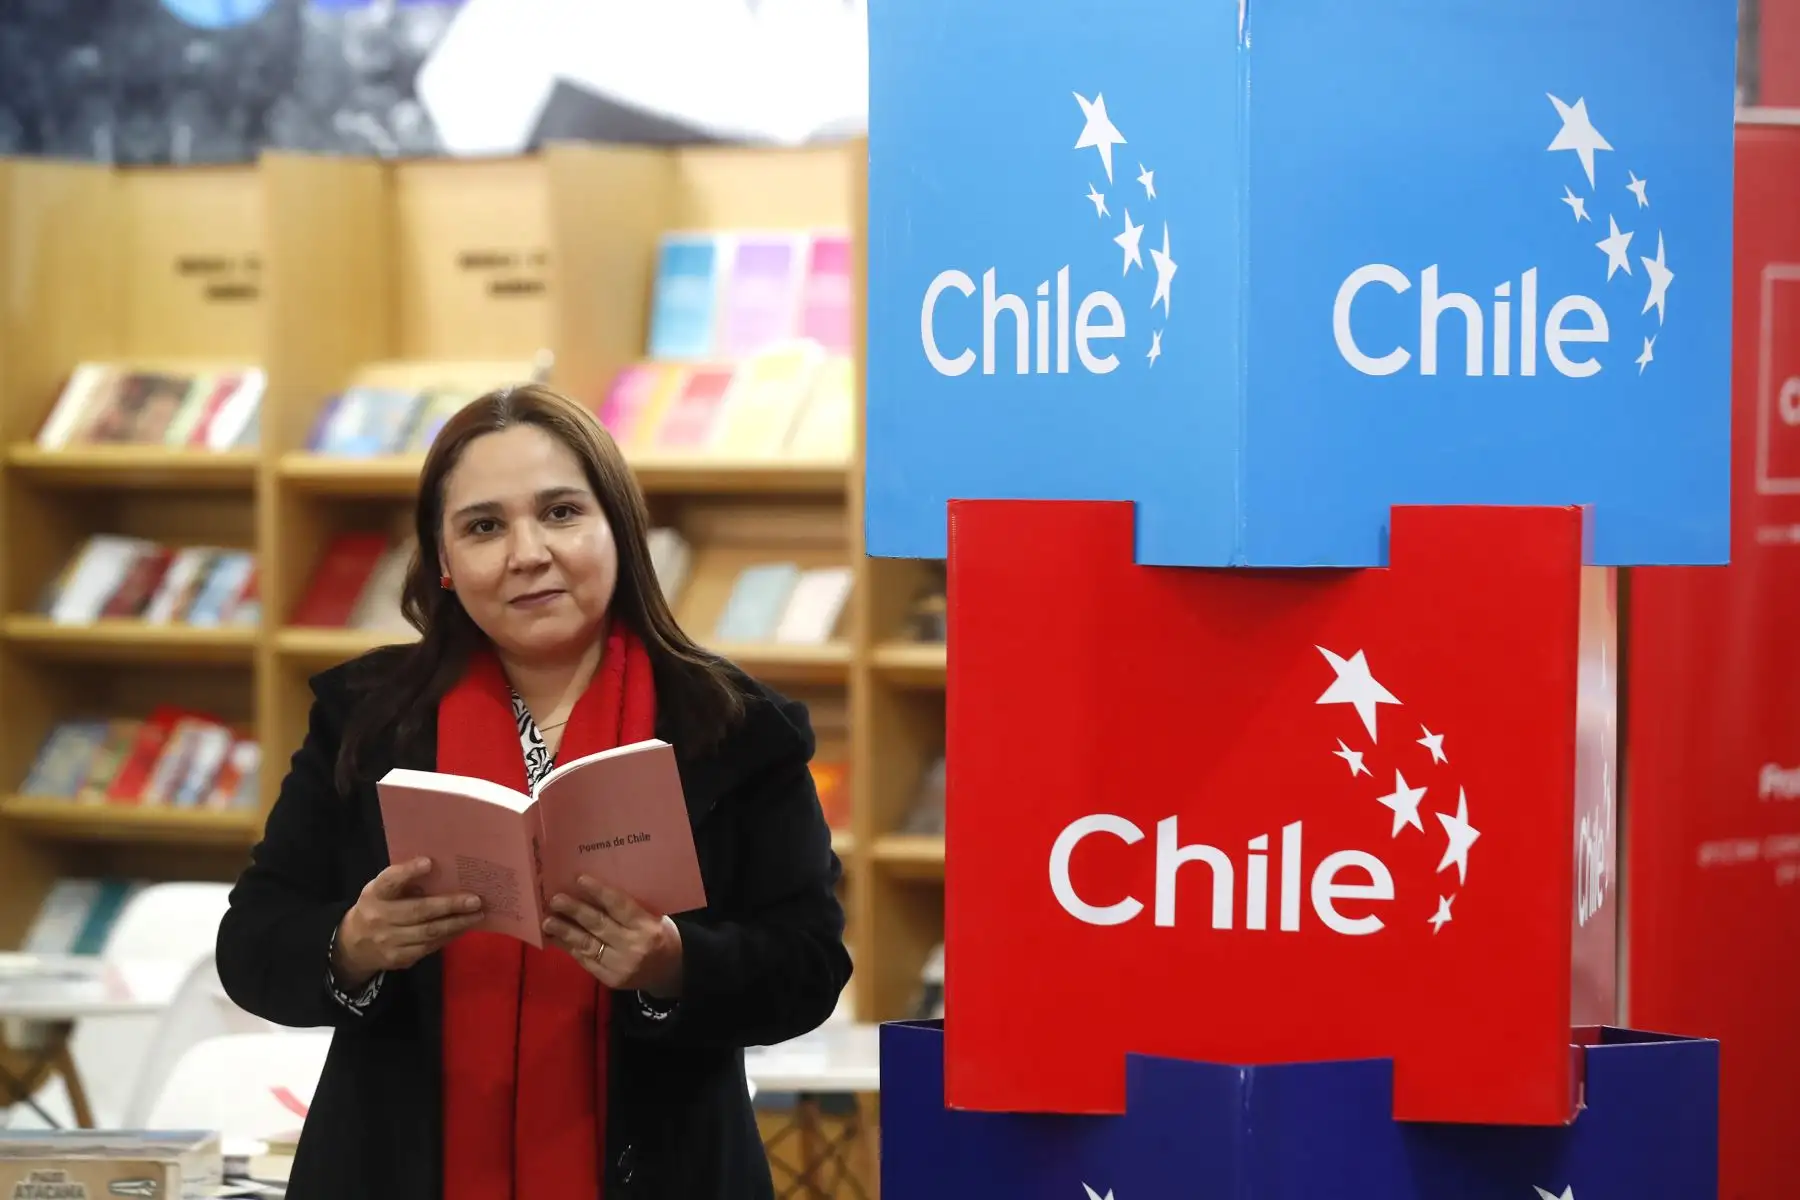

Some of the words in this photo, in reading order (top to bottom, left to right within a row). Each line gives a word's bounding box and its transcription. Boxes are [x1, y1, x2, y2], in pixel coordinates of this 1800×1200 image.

[921, 265, 1126, 376] Chile
[1333, 263, 1610, 378] Chile
[578, 840, 611, 854] Poema
[613, 836, 625, 847] de
[627, 832, 651, 844] Chile
[1050, 814, 1395, 935] Chile
[1578, 805, 1604, 927] Chile
